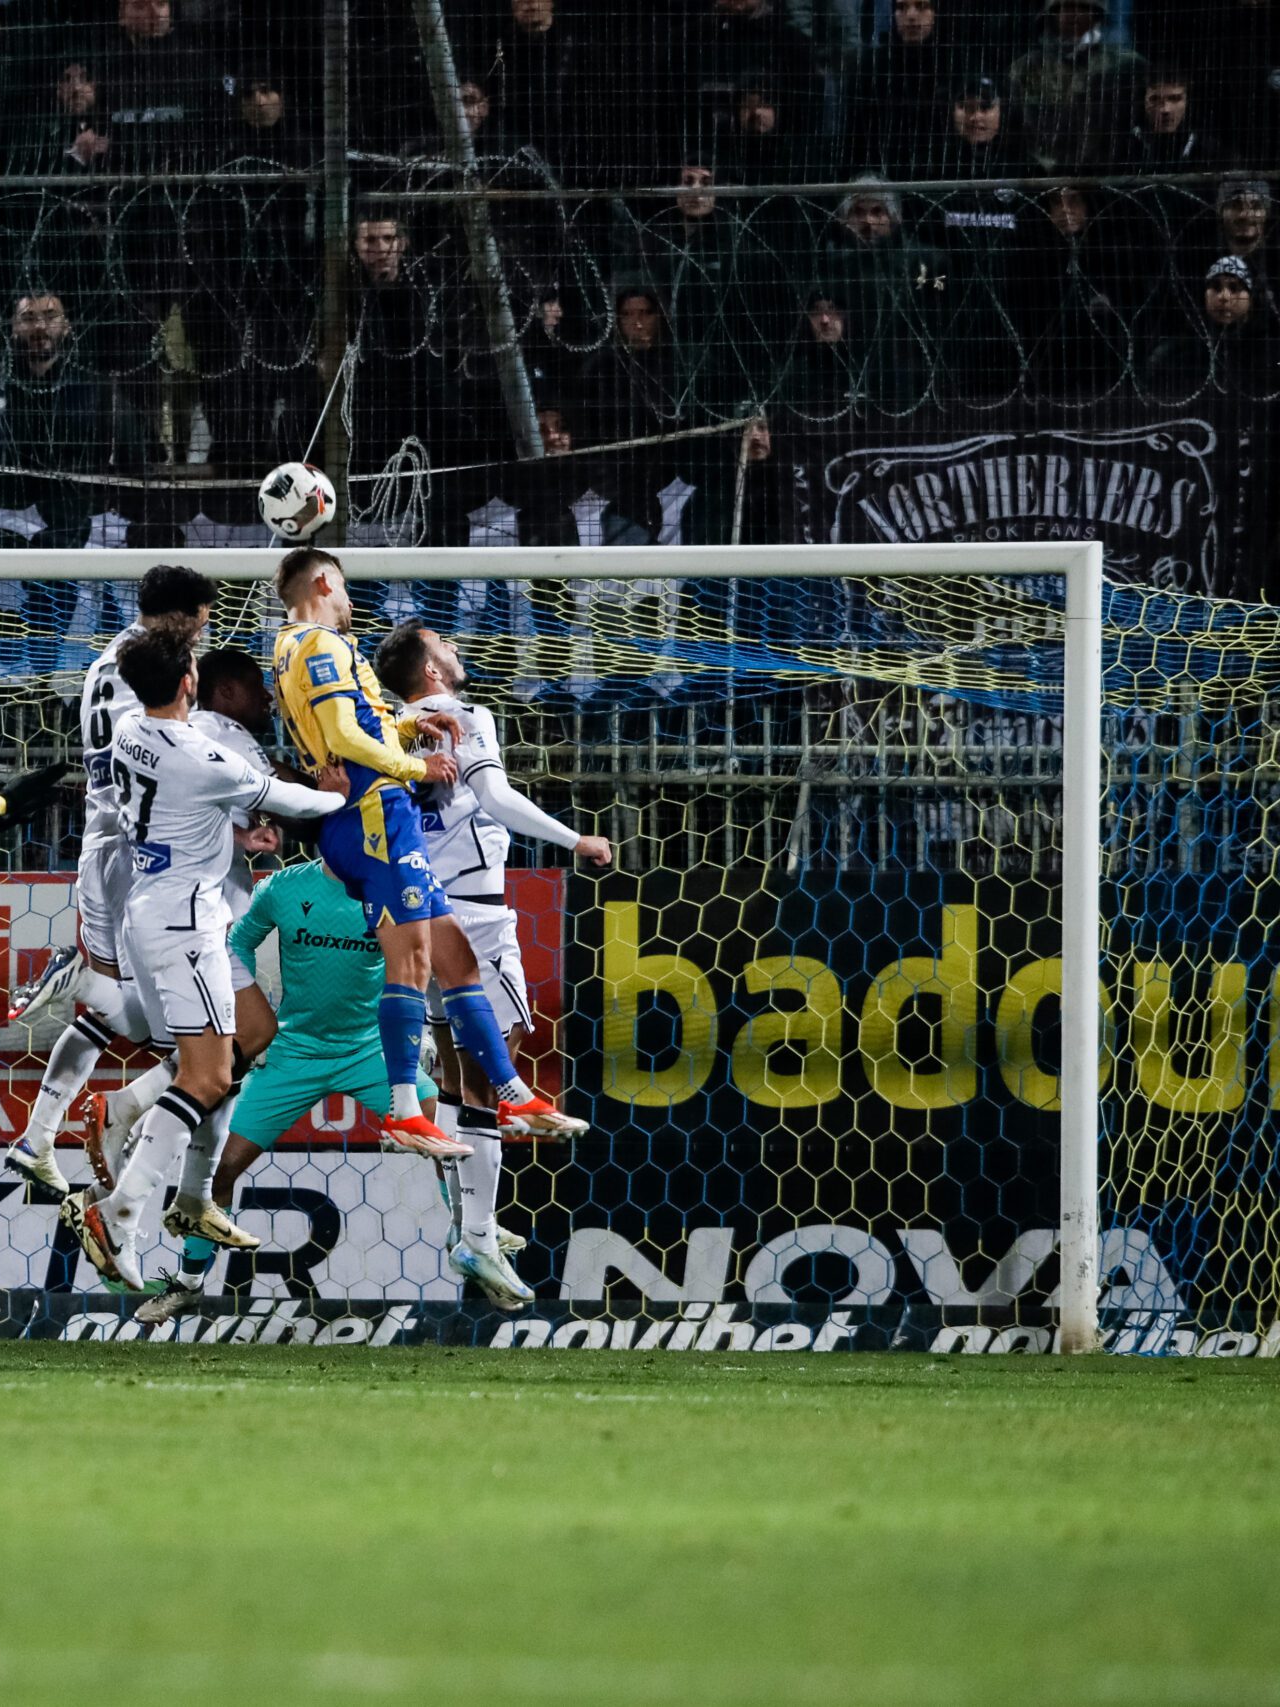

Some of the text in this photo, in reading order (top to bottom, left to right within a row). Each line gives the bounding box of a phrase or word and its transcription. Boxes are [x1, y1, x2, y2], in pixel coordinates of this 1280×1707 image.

[857, 454, 1197, 543] NORTHERNERS
[1033, 521, 1097, 541] FANS
[292, 928, 382, 953] Stoixima
[603, 900, 1280, 1113] badou
[558, 1224, 1186, 1310] NOVA
[488, 1302, 859, 1352] novibet
